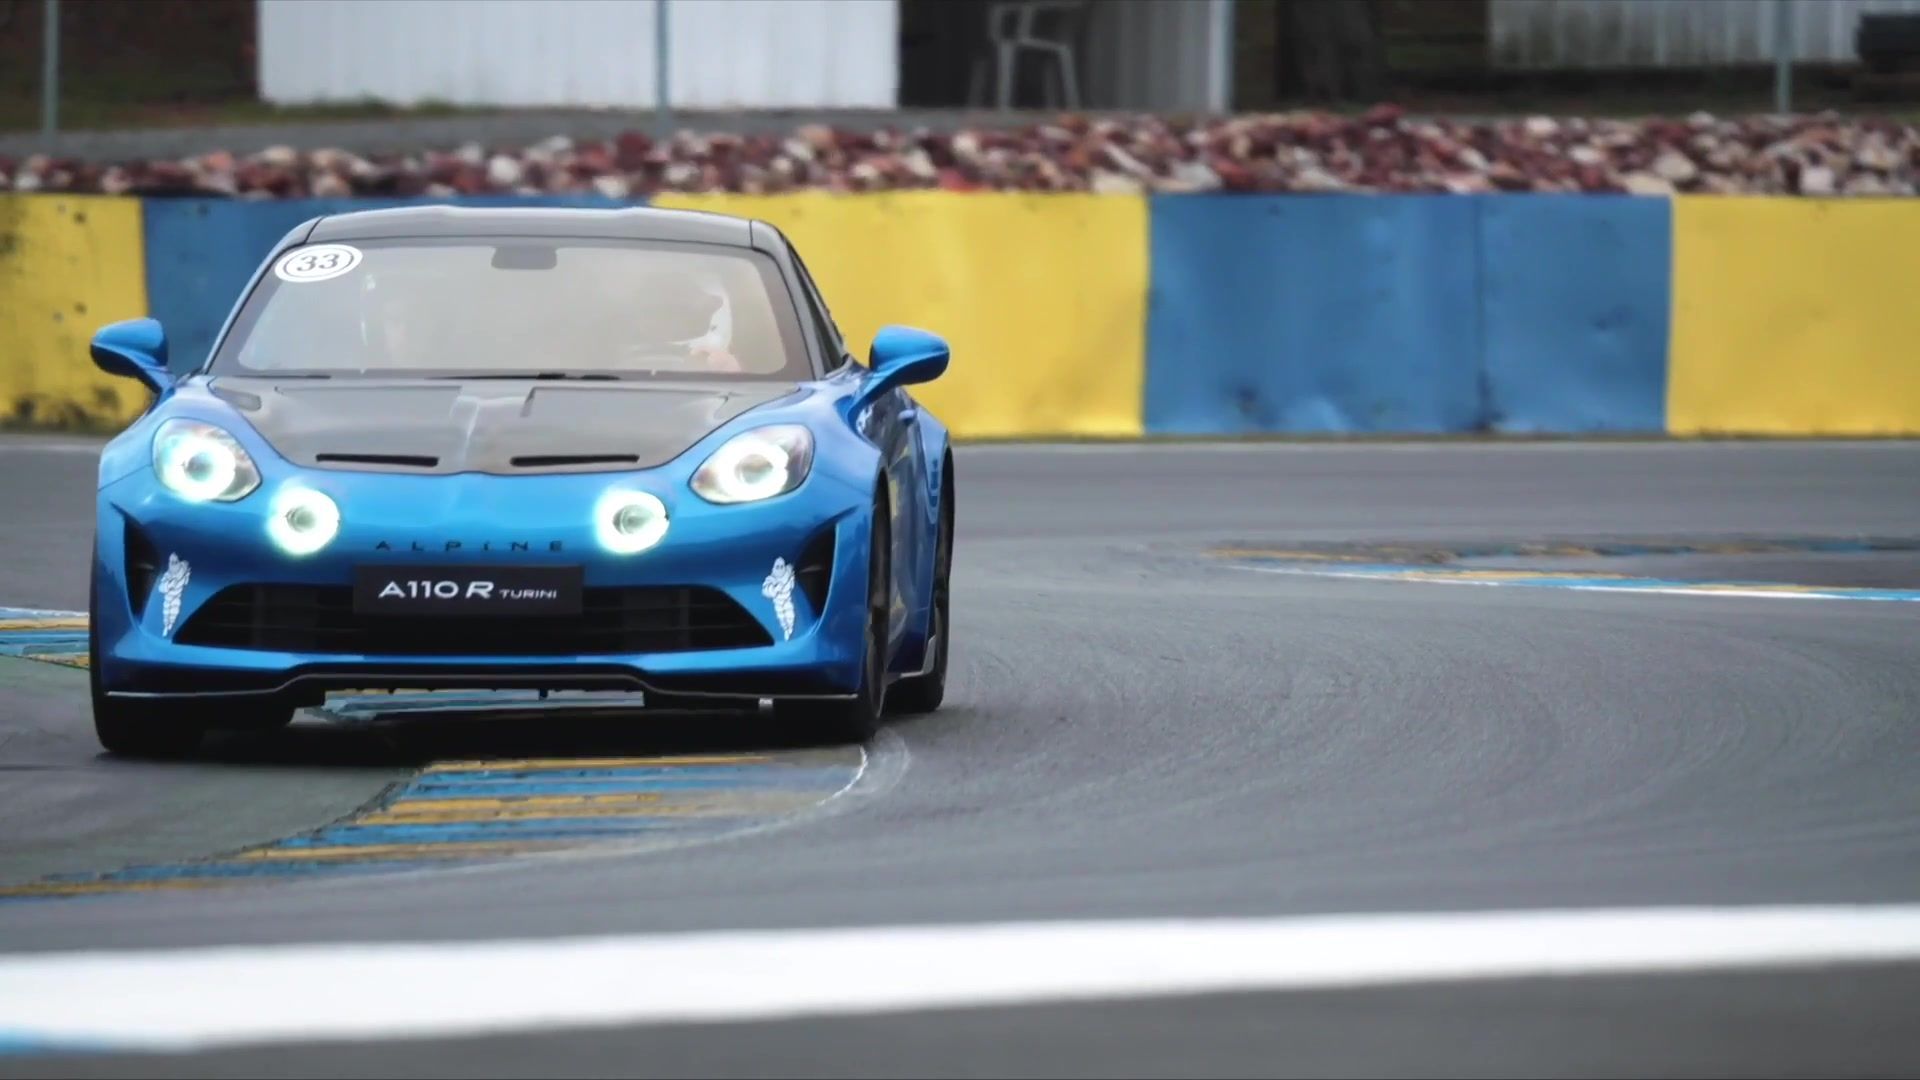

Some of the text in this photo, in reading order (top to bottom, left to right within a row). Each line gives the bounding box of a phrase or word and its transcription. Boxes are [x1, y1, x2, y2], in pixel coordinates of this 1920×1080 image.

[296, 253, 340, 272] 33
[376, 540, 563, 551] ALPINE
[378, 580, 557, 599] A110 R TURINI
